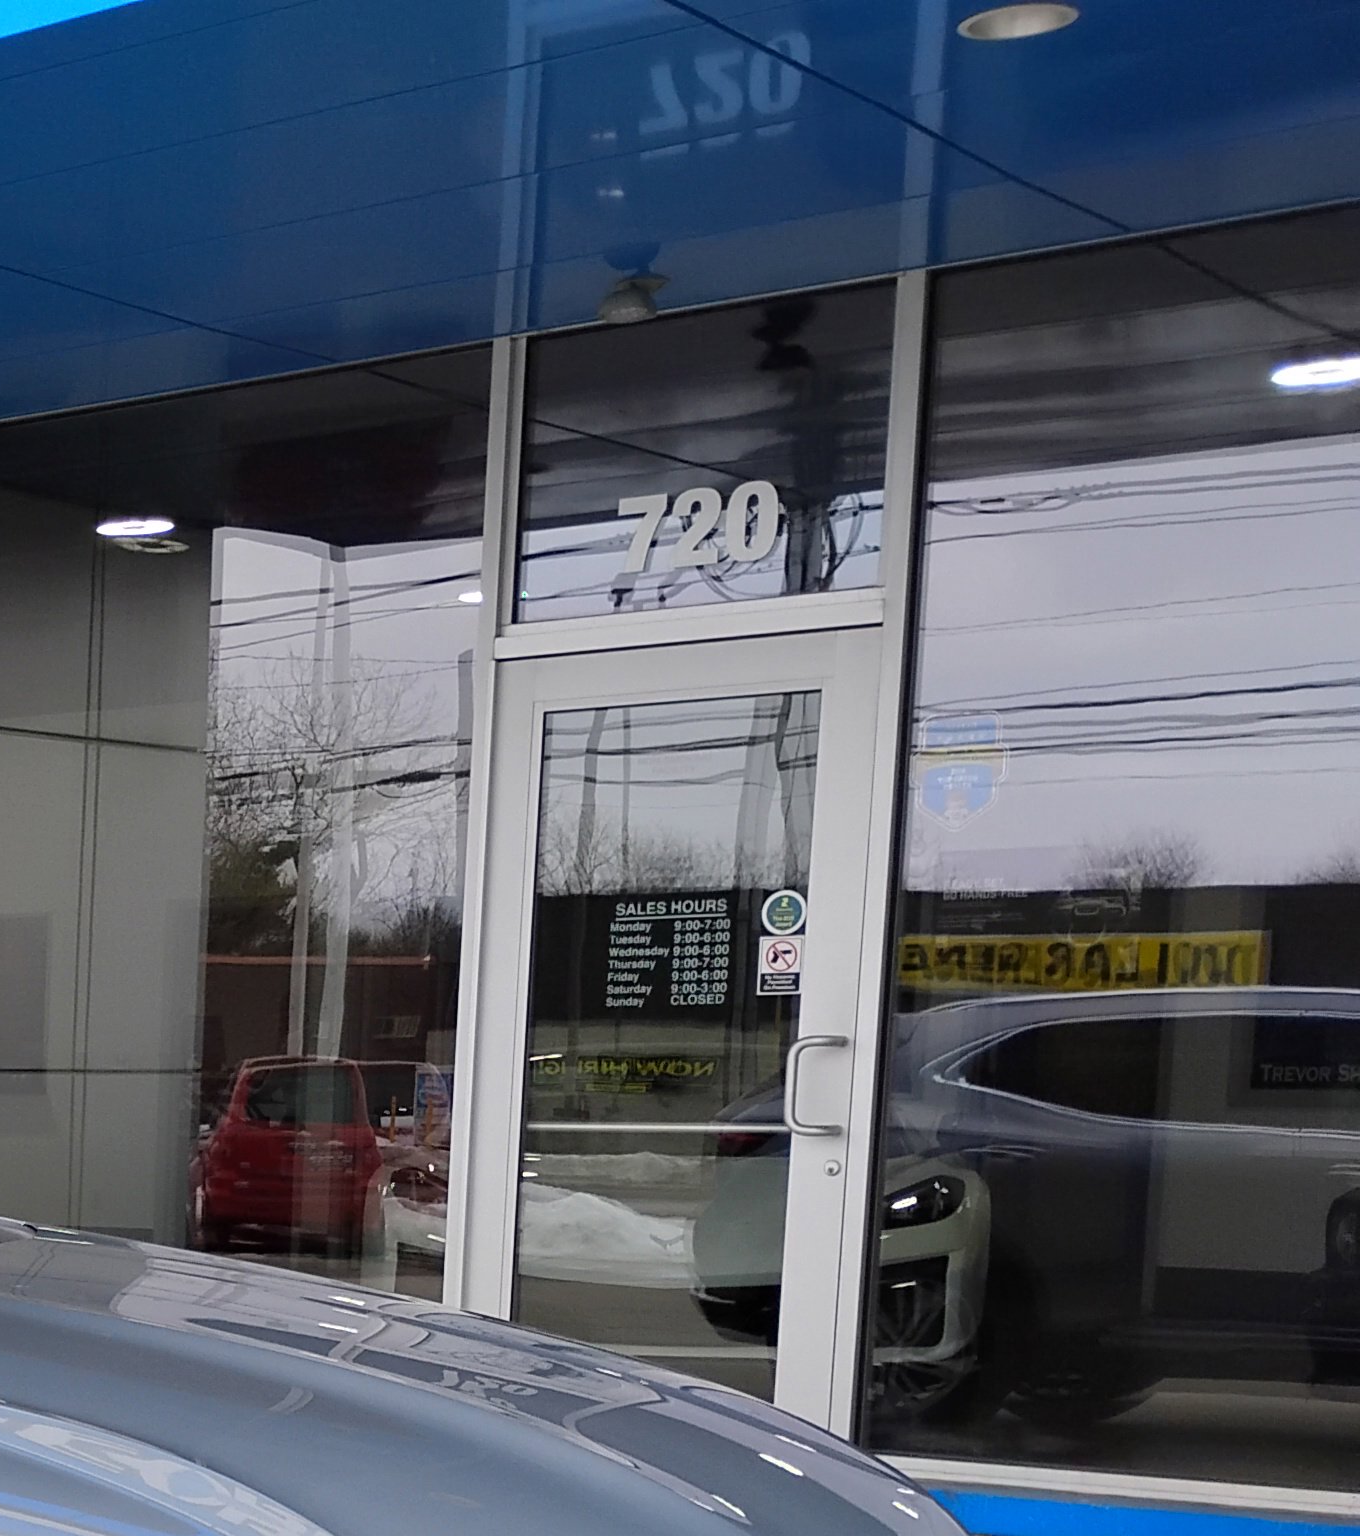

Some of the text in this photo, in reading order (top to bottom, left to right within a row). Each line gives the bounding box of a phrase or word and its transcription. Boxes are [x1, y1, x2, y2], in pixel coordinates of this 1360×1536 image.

[617, 479, 781, 574] 720
[615, 898, 728, 916] SALES HOURS
[609, 918, 731, 933] Monday 9:00-7:00
[609, 931, 730, 946] Tuesday 9:00-6:00
[608, 944, 730, 958] Wednesday 9:00-6:00
[607, 957, 729, 970] Thursday 9:00-7:00
[606, 969, 728, 984] Friday 9:00-6:00
[606, 982, 727, 996] Saturday 9:00-3:00
[605, 994, 725, 1008] Sunday CLOSED
